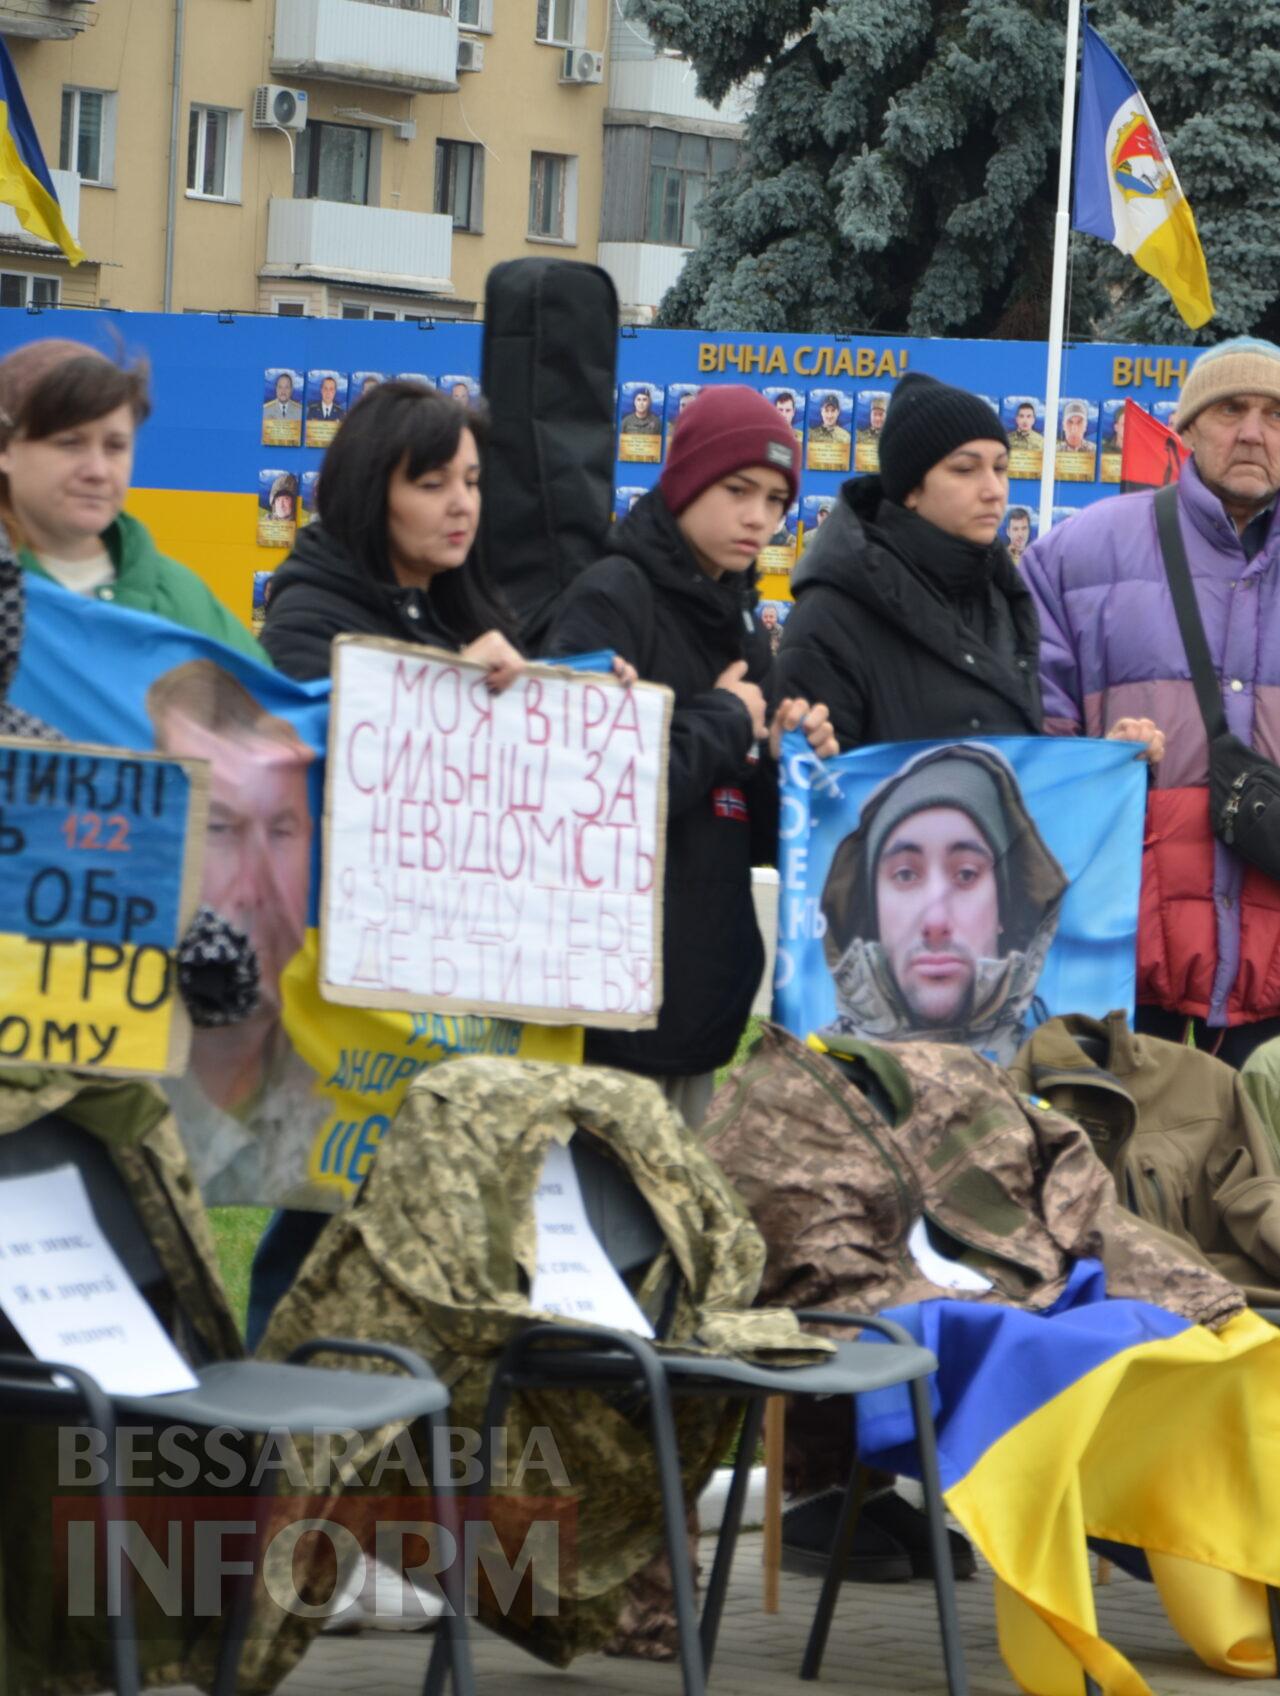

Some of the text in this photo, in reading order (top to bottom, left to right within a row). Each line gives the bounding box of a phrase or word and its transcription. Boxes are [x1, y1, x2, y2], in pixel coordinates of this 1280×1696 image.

[698, 342, 909, 378] ВІЧНА СЛАВА!
[1113, 357, 1188, 389] ВІЧН
[392, 659, 645, 754] МОЯ ВІРА
[348, 721, 638, 824] СИЛЬНІШ ЗА
[62, 812, 131, 851] 122
[534, 885, 654, 954] ТЕБЕ
[26, 935, 172, 1012] ТРО
[351, 927, 412, 993] ДЕ
[466, 938, 523, 1002] ТИ
[541, 944, 587, 1009] НЕ
[326, 1048, 432, 1095] АНДР
